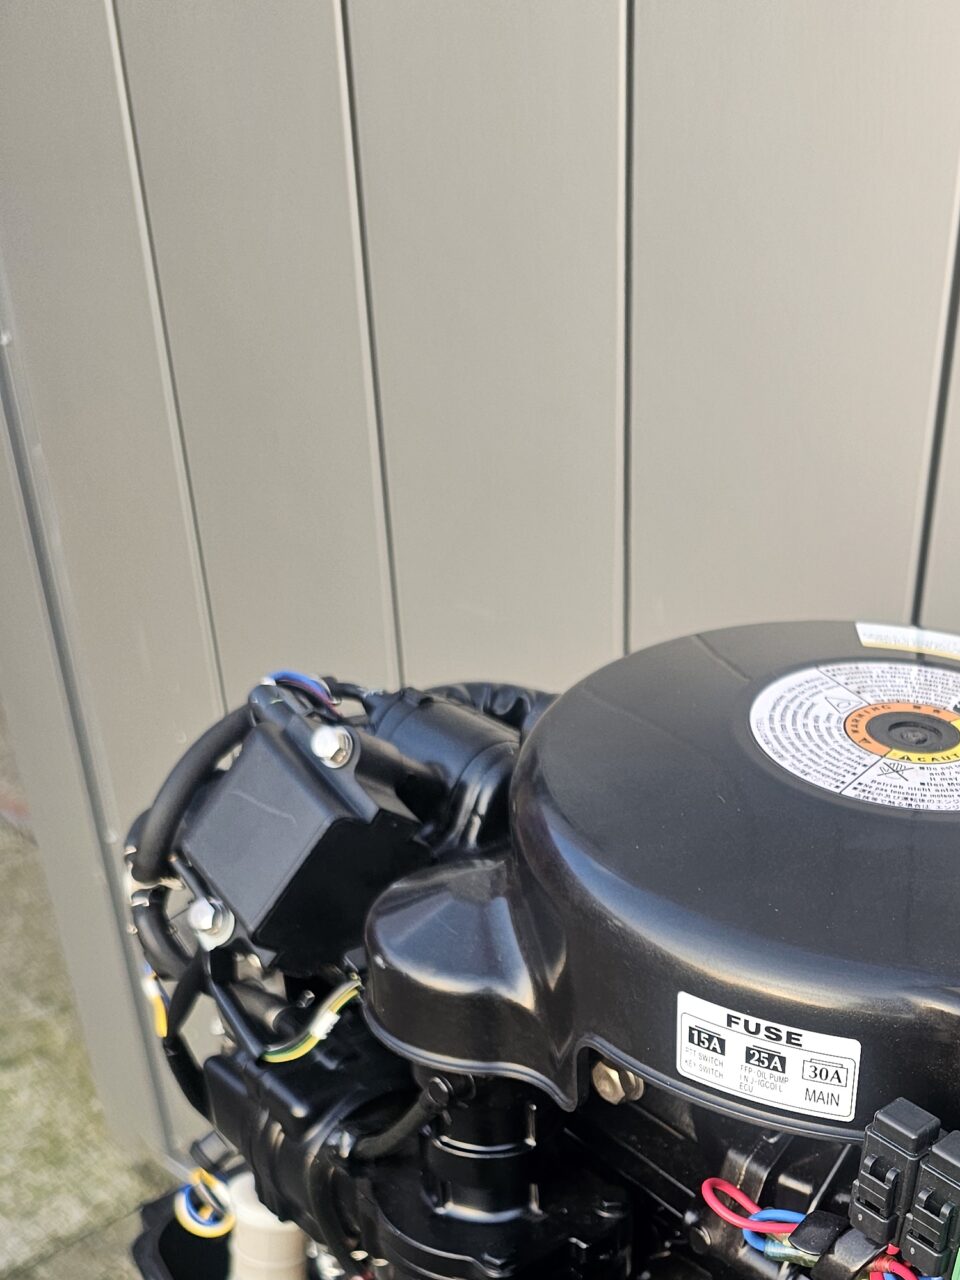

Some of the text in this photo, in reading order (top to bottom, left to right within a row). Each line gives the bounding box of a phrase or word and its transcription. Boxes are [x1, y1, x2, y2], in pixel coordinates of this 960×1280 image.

[726, 1013, 803, 1047] FUSE
[692, 1030, 721, 1053] 15A
[698, 1052, 724, 1068] SWITCH
[749, 1050, 783, 1072] 25A
[698, 1063, 724, 1079] SWITCH
[769, 1072, 789, 1084] PUMP
[808, 1065, 842, 1083] 30A
[739, 1081, 754, 1093] ECU
[804, 1087, 840, 1107] MAIN
